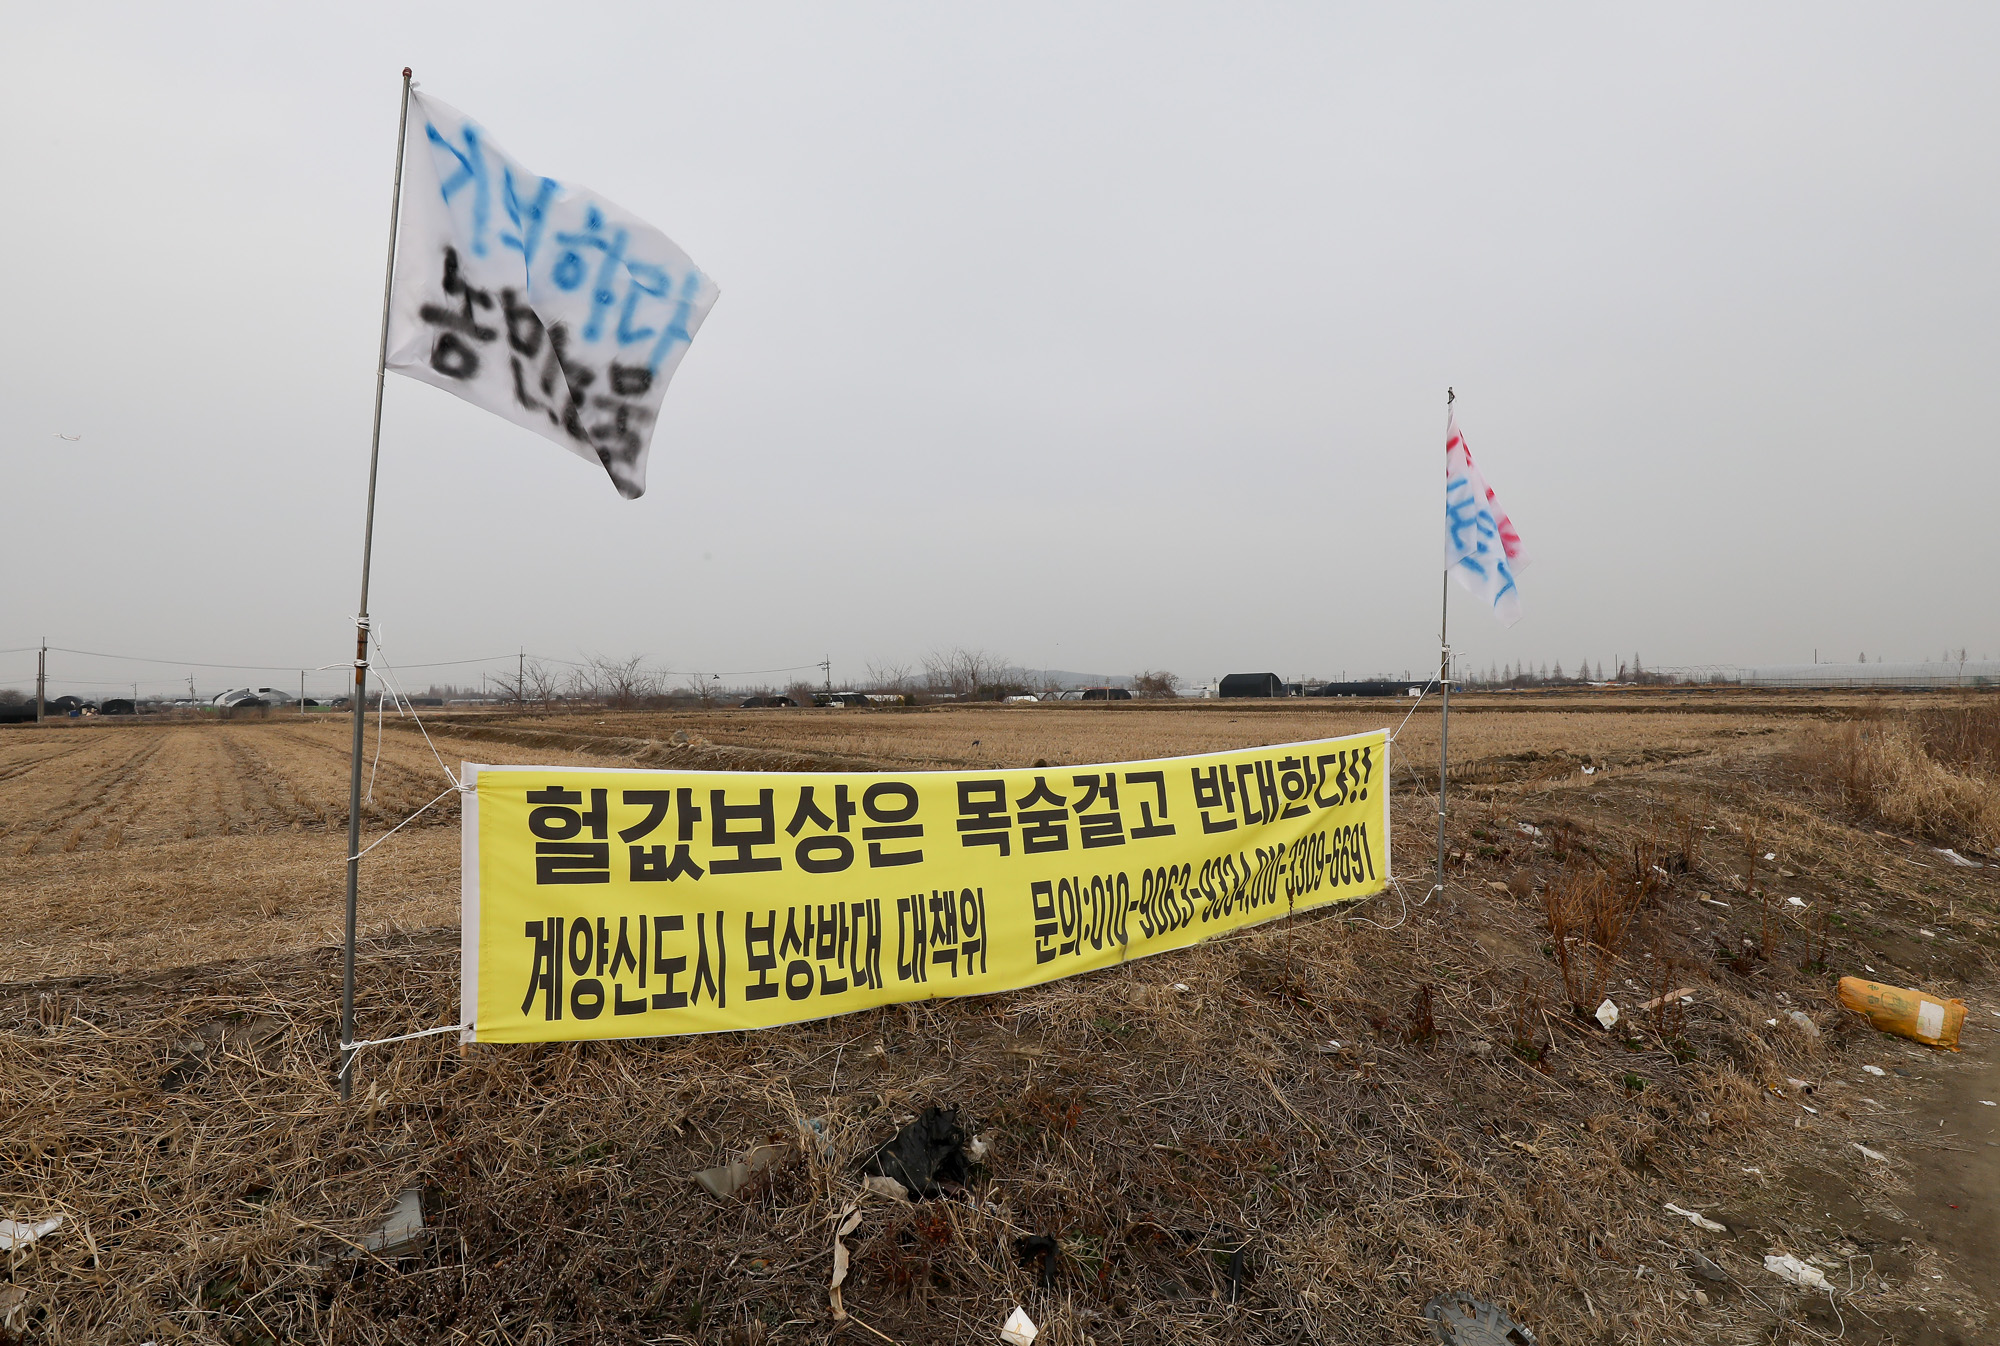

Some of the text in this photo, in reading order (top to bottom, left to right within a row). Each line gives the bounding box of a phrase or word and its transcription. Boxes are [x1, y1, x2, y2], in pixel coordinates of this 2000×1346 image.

[527, 746, 1372, 885] 헐값보상은 목숨걸고 반대한다!!
[520, 910, 727, 1021] 계양신도시
[745, 898, 883, 1002] 보상반대
[896, 887, 988, 978] 대책위
